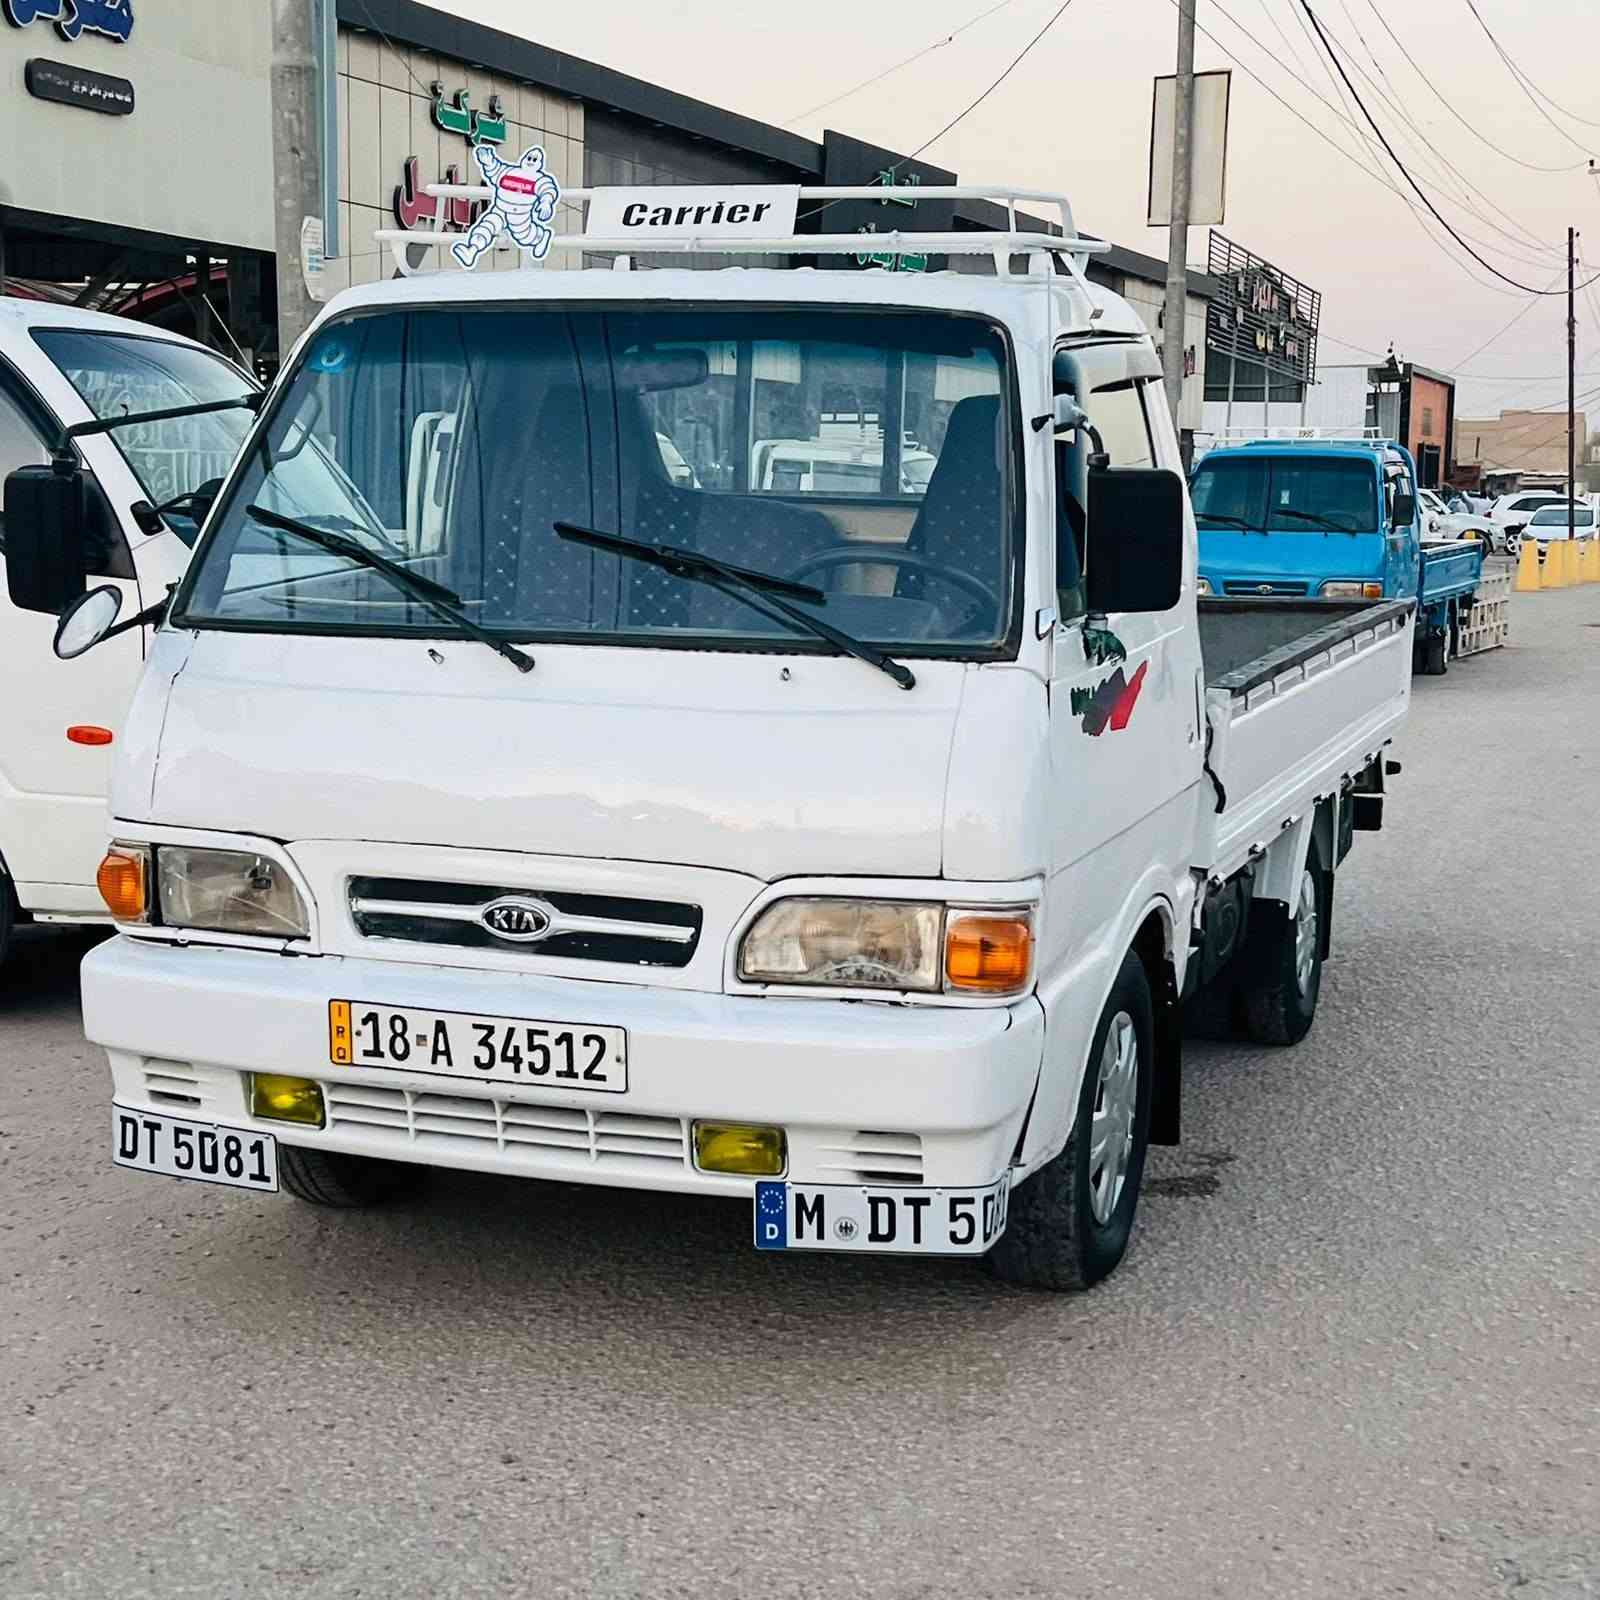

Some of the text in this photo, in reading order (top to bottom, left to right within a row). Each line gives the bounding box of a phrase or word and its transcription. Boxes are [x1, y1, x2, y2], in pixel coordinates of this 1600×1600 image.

[622, 201, 772, 227] Carrier
[493, 909, 536, 930] KIA
[471, 1023, 608, 1083] 34512
[119, 1115, 271, 1184] DT 5081
[765, 1223, 779, 1240] D
[794, 1192, 825, 1241] M
[867, 1196, 932, 1245] DT
